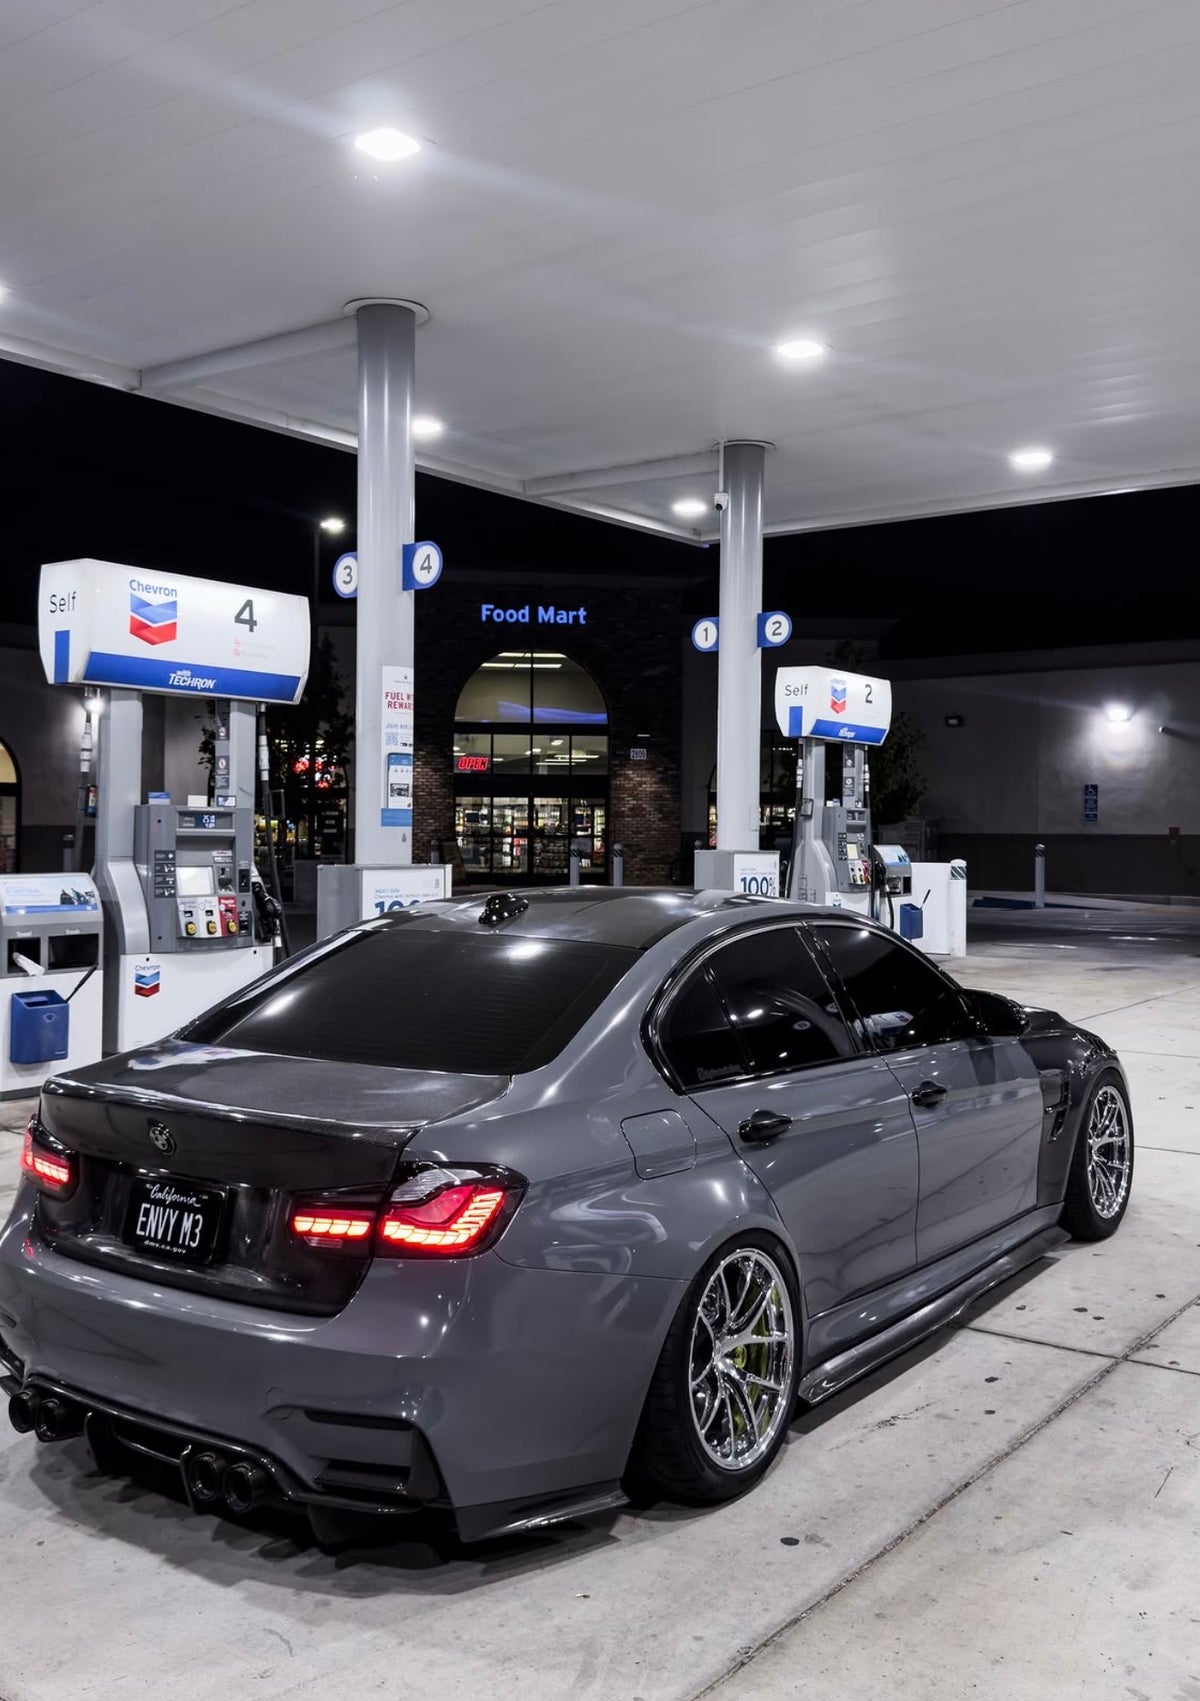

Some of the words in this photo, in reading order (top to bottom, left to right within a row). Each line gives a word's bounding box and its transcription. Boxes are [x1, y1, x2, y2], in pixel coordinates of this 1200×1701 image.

[420, 553, 433, 574] 4
[342, 565, 353, 585] 3
[129, 579, 178, 598] Chevron
[49, 591, 77, 613] Self
[234, 598, 257, 633] 4
[481, 604, 530, 623] Food
[538, 606, 587, 624] Mart
[703, 627, 708, 641] 1
[771, 620, 782, 636] 2
[169, 673, 217, 690] TECHRON
[784, 684, 808, 696] Self
[385, 691, 404, 701] FUEL
[865, 683, 873, 704] 2
[458, 756, 489, 771] OPEN
[150, 1184, 201, 1207] California
[136, 1203, 179, 1241] ENVY
[179, 1211, 203, 1247] M3
[144, 1240, 186, 1254] dmv.ca.gov
